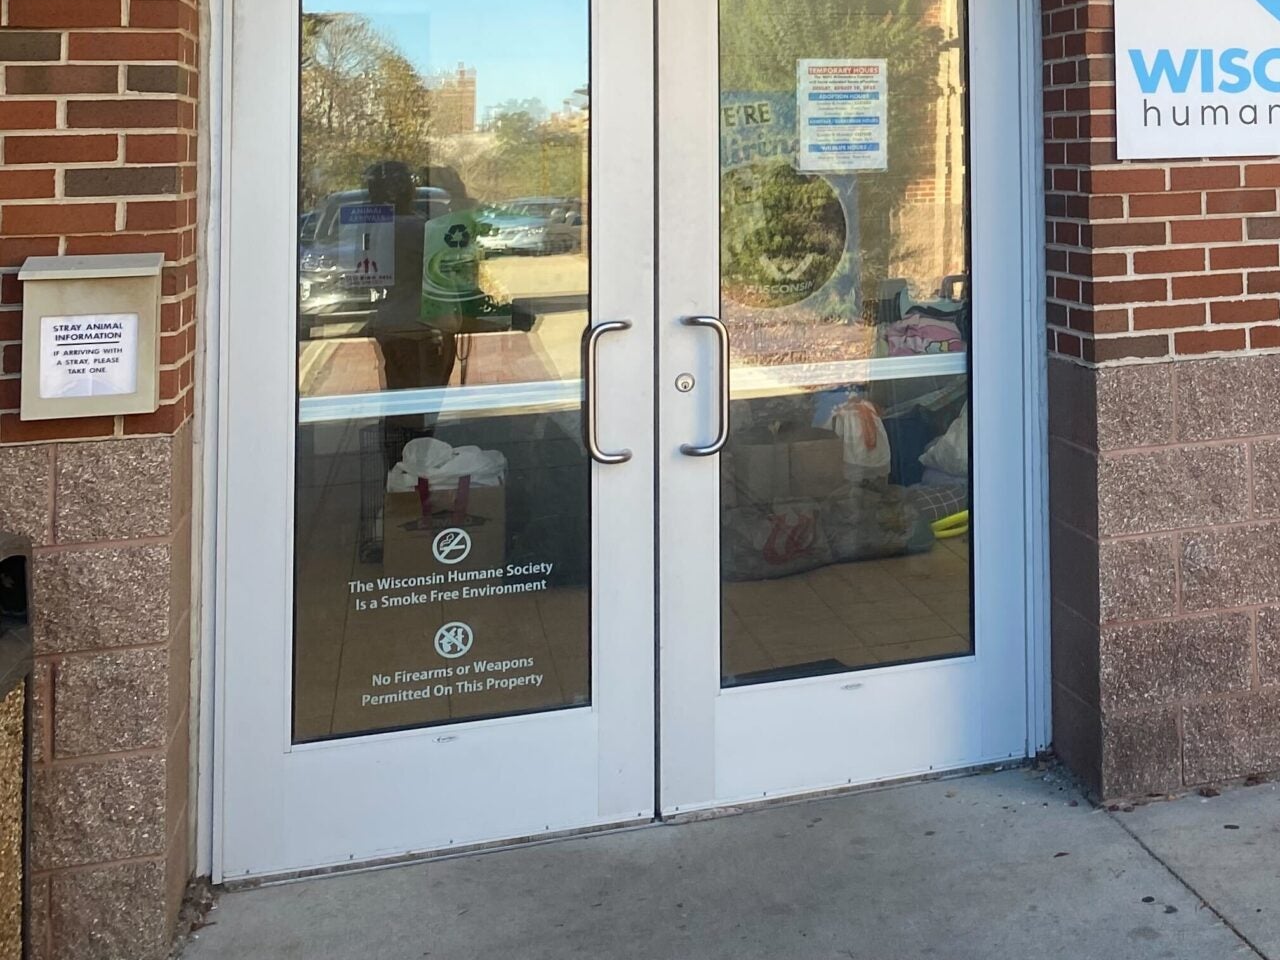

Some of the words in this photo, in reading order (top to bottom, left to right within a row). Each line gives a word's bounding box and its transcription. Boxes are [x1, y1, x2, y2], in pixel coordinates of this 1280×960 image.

[853, 66, 878, 74] HOURS
[722, 102, 771, 128] E'RE
[53, 324, 82, 332] STRAY
[86, 322, 123, 331] ANIMAL
[55, 332, 122, 341] INFORMATION
[63, 348, 100, 356] ARRIVING
[348, 580, 374, 593] The
[377, 572, 445, 590] Wisconsin
[448, 567, 504, 583] Humane
[506, 561, 553, 576] Society
[355, 599, 366, 610] Is
[369, 600, 378, 609] a
[381, 593, 427, 608] Smoke
[431, 589, 459, 602] Free
[463, 579, 547, 599] Environment
[372, 673, 391, 687] No
[394, 667, 453, 684] Firearms
[456, 664, 470, 675] or
[474, 656, 534, 674] Weapons
[362, 686, 430, 706] Permitted
[433, 684, 452, 697] On
[456, 680, 483, 693] This
[486, 673, 544, 690] Property
